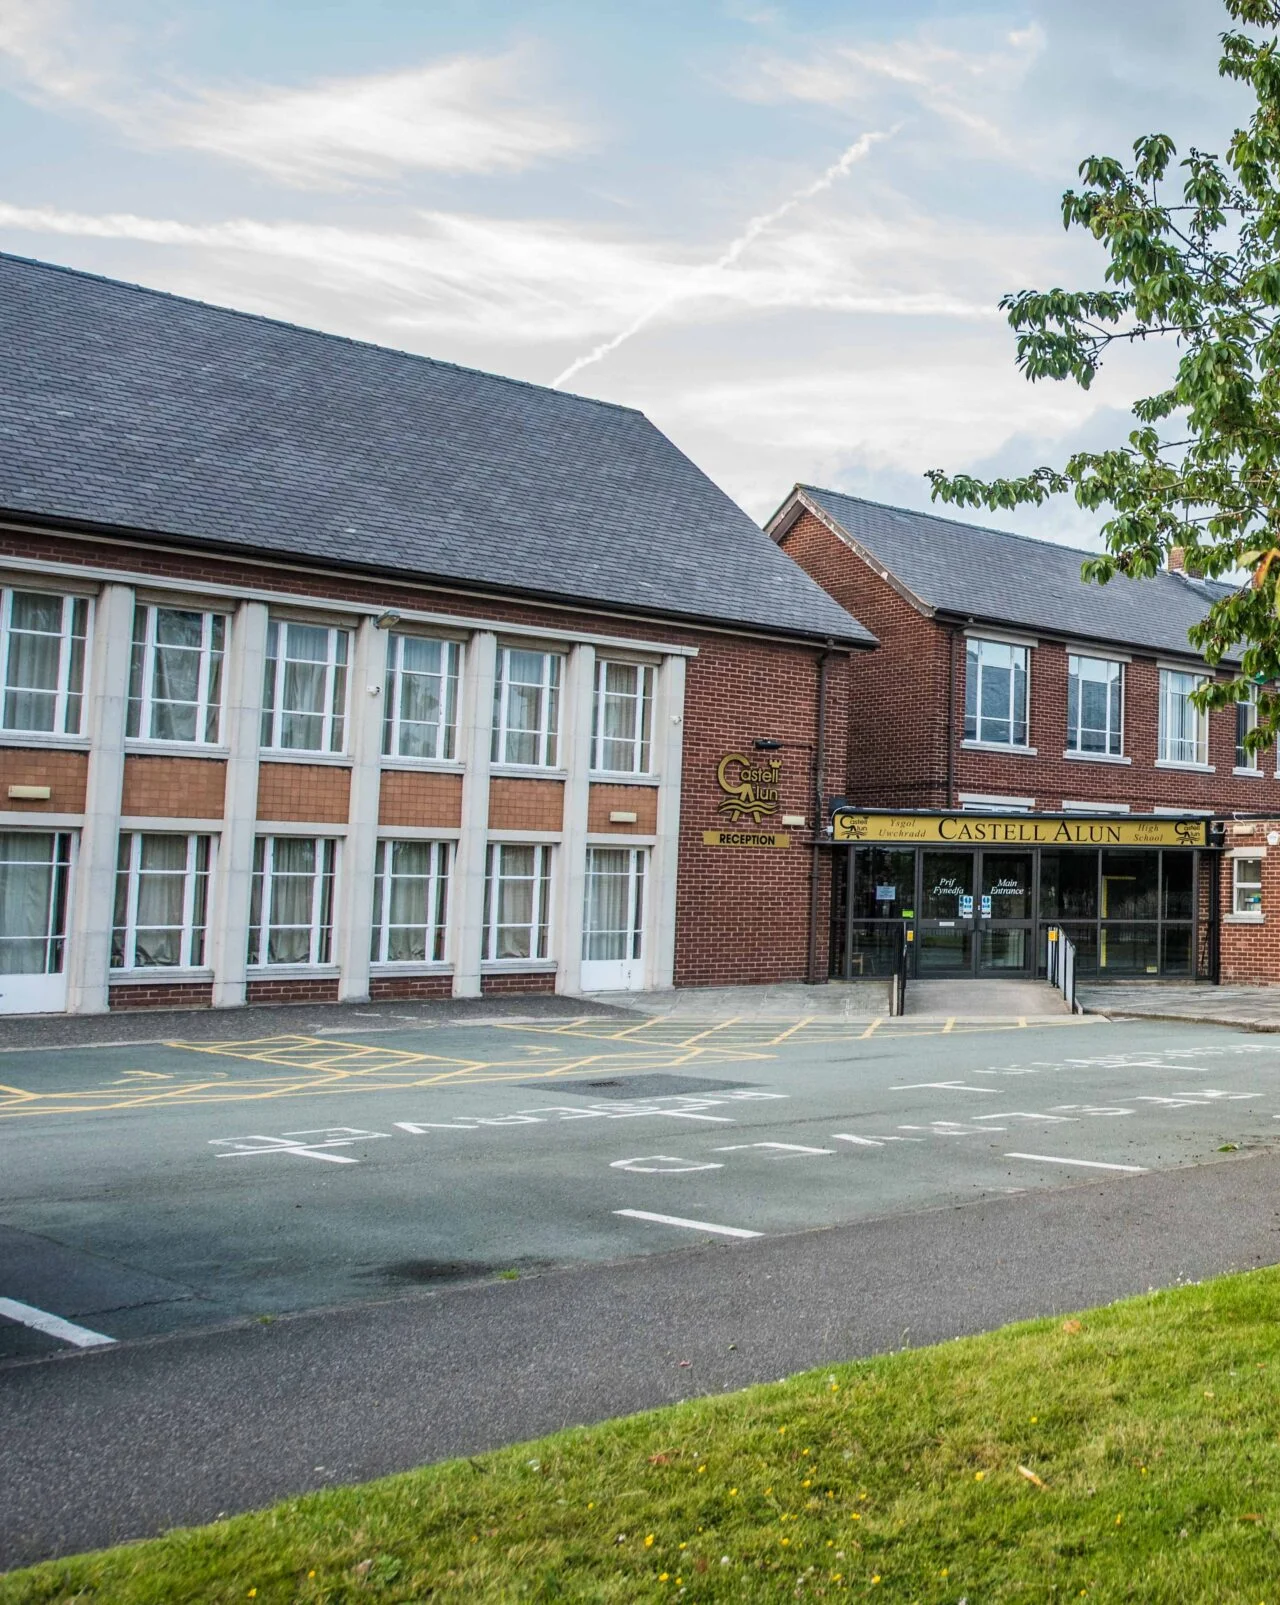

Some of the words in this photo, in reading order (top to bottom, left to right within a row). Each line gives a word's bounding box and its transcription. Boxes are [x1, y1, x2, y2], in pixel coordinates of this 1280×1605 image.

[719, 753, 779, 793] Castell
[890, 819, 916, 828] Ysgol
[879, 829, 927, 837] Uwchradd
[938, 817, 1046, 841] CASTELL
[1053, 820, 1121, 842] ALUN
[1137, 824, 1159, 833] High
[719, 833, 776, 845] RECEPTION
[1134, 833, 1163, 842] School
[939, 878, 956, 887] Prif
[997, 879, 1018, 887] Main
[933, 886, 964, 896] Fynedfa
[990, 887, 1024, 895] Entrance
[207, 1091, 790, 1150] RESERVED
[608, 1089, 1266, 1173] RESERVED
